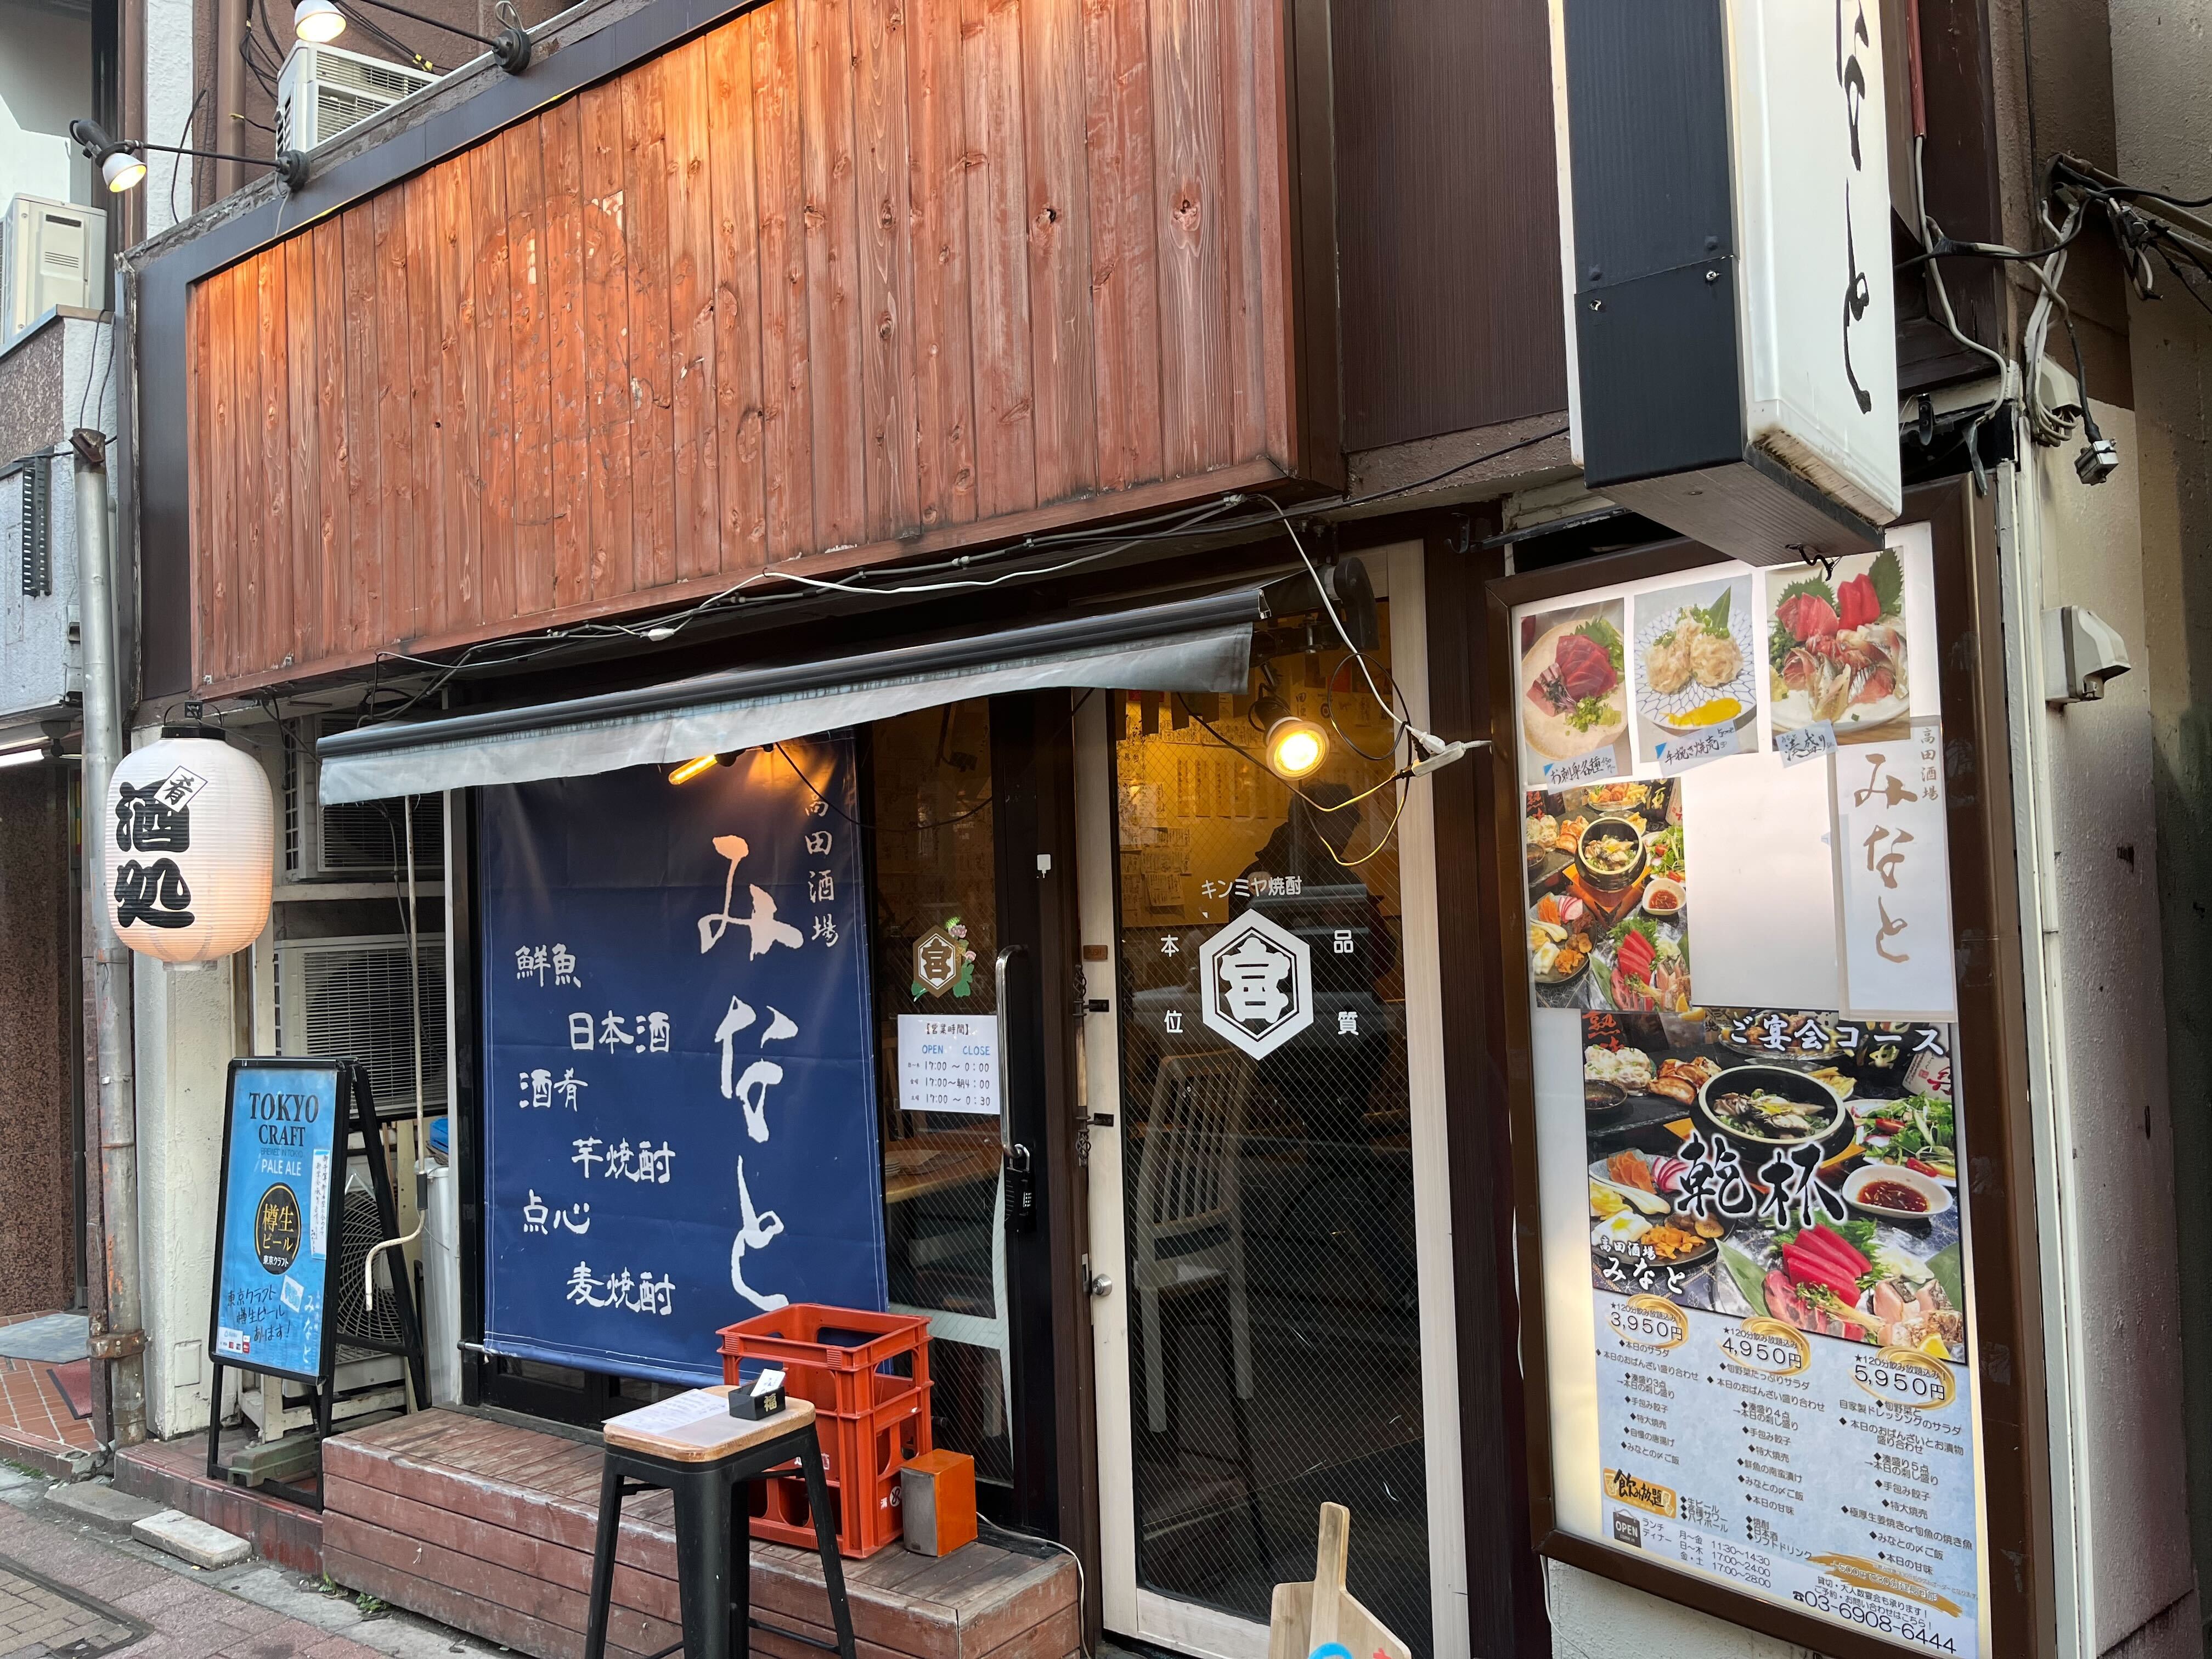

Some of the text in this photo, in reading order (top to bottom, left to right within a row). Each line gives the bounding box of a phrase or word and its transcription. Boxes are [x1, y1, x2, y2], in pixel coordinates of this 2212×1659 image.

[1921, 727, 1939, 801] 高田酒場
[164, 774, 195, 805] 肴
[114, 779, 195, 928] 酒処
[805, 781, 839, 947] 高田酒場
[1854, 753, 1918, 963] みなと
[1200, 875, 1302, 900] キンミヤ焼酎
[515, 943, 582, 988] 鮮魚
[568, 1010, 670, 1054] 日本酒
[1730, 1015, 1945, 1056] ご宴会コース
[922, 1045, 990, 1056] OPEN CLOSE
[698, 834, 804, 1312] みなと
[925, 1061, 947, 1071] 17:00
[518, 1067, 588, 1111] 酒肴
[926, 1093, 948, 1104] 17:00
[249, 1092, 319, 1123] TOKYO
[258, 1124, 306, 1147] CRAFT
[261, 1158, 302, 1176] PALE ALE
[572, 1136, 676, 1183] 芋焼酎
[1675, 1133, 1846, 1227] 乾杯
[262, 1203, 294, 1232] 樽生
[522, 1189, 590, 1234] 点心
[263, 1233, 294, 1251] ビール
[1600, 1235, 1656, 1261] 高田酒場
[263, 1255, 289, 1268] 東京クラフト
[566, 1260, 676, 1315] 麦焼酎
[1602, 1256, 1685, 1294] みなと
[228, 1284, 276, 1308] 東京クラフト
[236, 1305, 285, 1325] 樽生ビール
[1611, 1311, 1683, 1341] 3,950円
[303, 1295, 314, 1364] みなと
[1626, 1341, 1669, 1357] 本日のサラダ
[1722, 1337, 1802, 1369] 4,950円
[1854, 1364, 1945, 1401] 5,950円
[763, 1392, 778, 1412] 福
[1631, 1397, 1668, 1413] 手包み餃子
[1750, 1427, 1791, 1446] 手包み餃子
[1877, 1435, 1923, 1455] 盛り合わせ
[1874, 1460, 1939, 1486] 本日の刺し盛り
[1613, 1469, 1664, 1508] 飲み放題
[1883, 1480, 1931, 1502] 手包み餃子
[1688, 1497, 1719, 1513] 生ビール
[1753, 1495, 1795, 1516] 本日の甘味
[1890, 1500, 1929, 1520] 特大焼売
[1615, 1521, 1639, 1538] OPEN
[1643, 1517, 1664, 1531] ランチ
[1755, 1535, 1812, 1559] ソフトドリンク
[1886, 1553, 1934, 1576] 本日の甘味
[1804, 1590, 1957, 1654] 03-6908-6444
